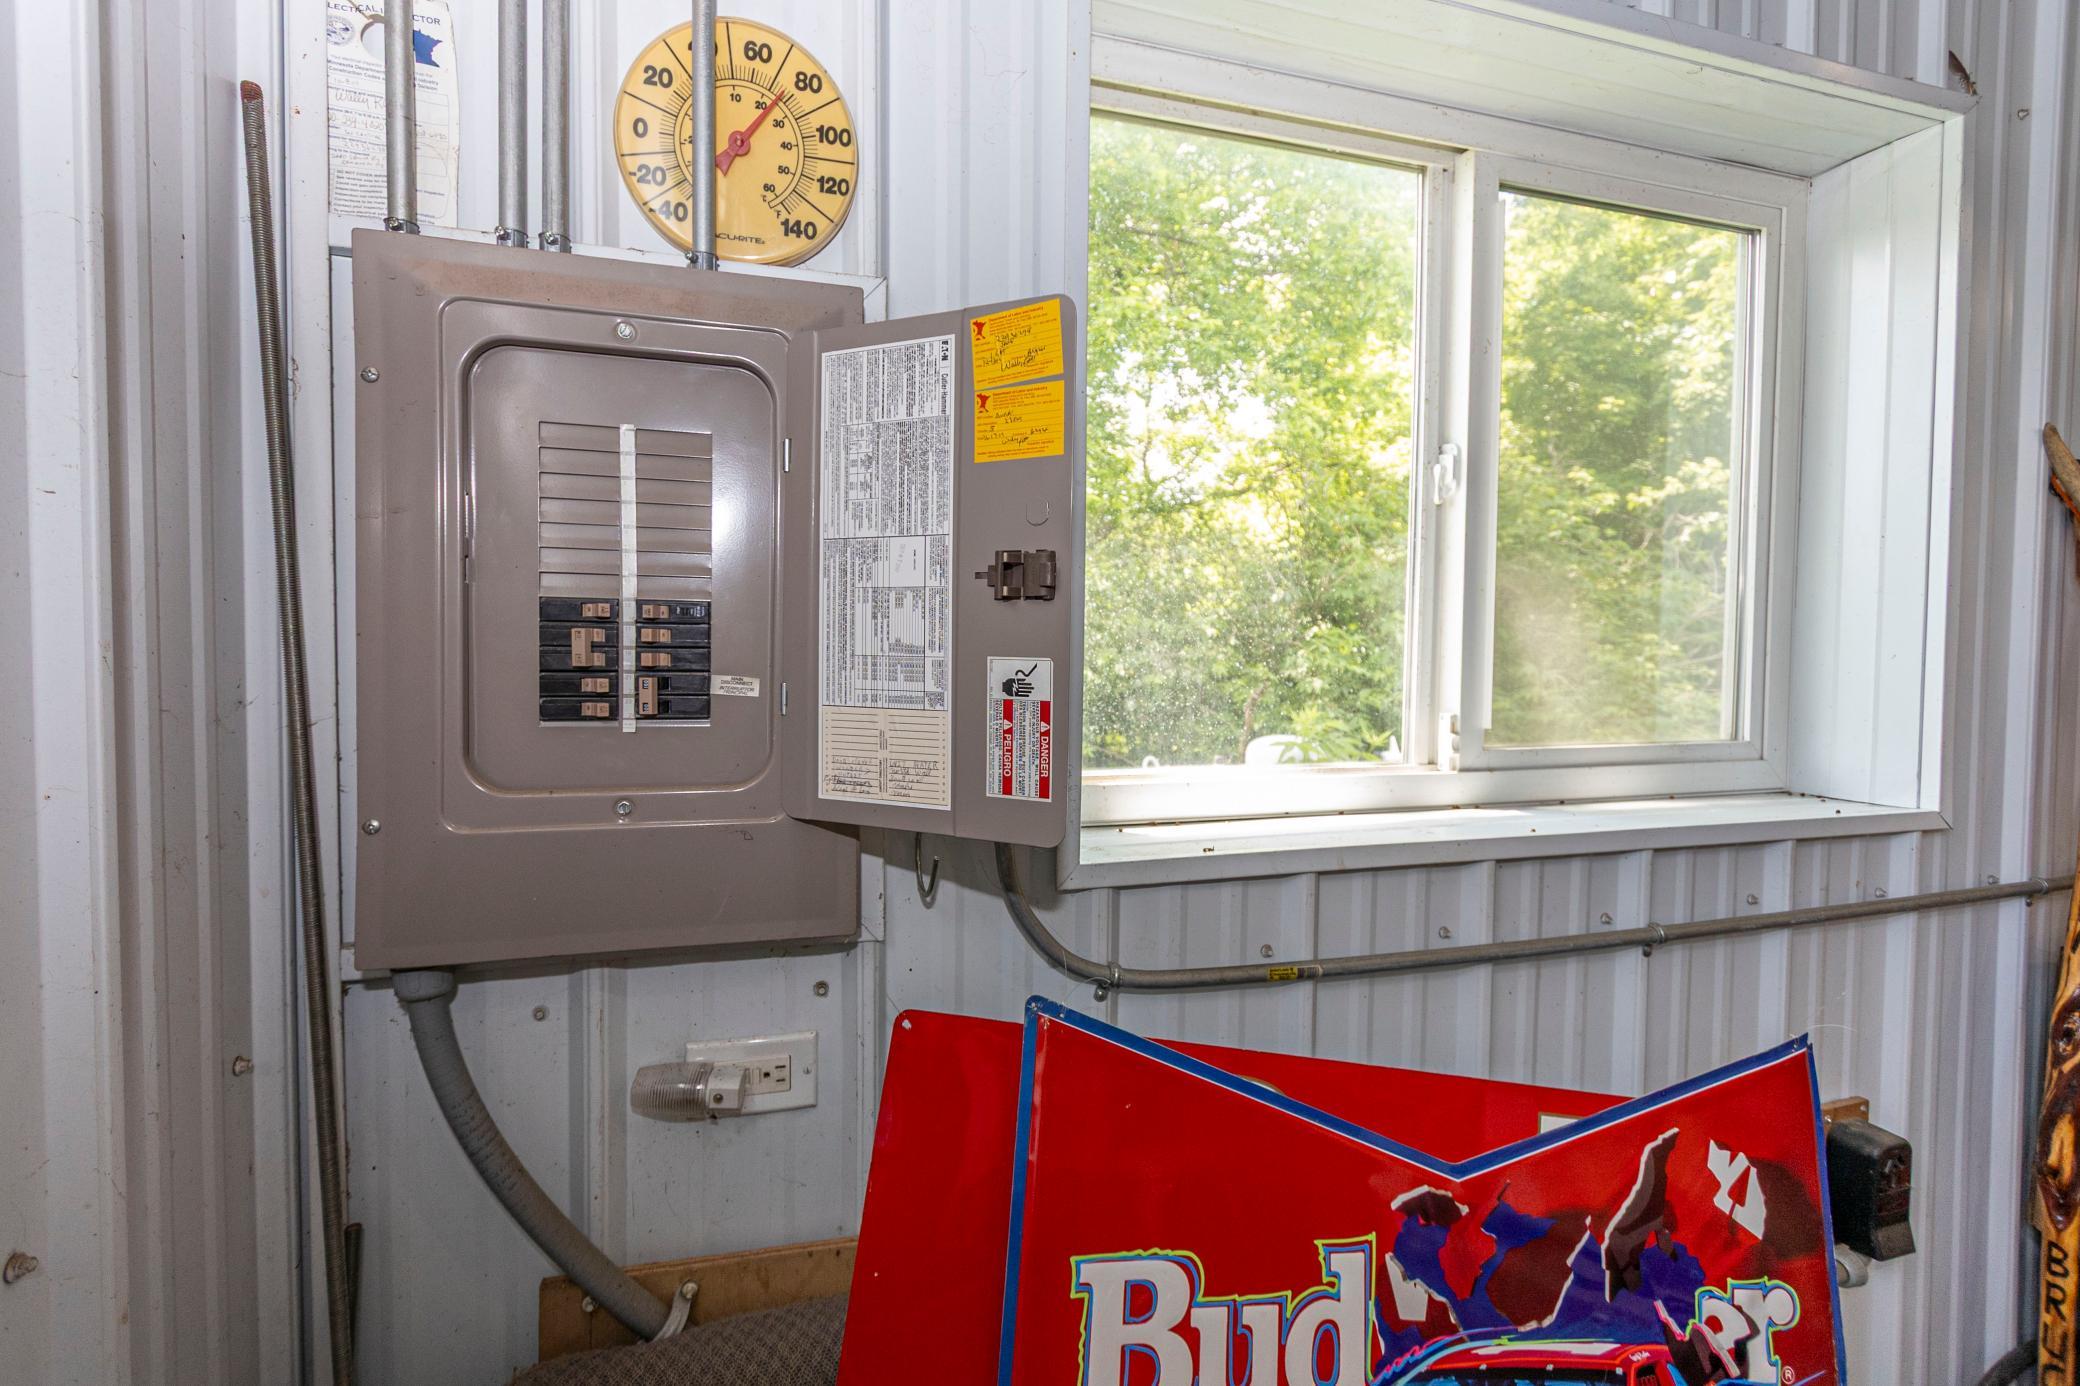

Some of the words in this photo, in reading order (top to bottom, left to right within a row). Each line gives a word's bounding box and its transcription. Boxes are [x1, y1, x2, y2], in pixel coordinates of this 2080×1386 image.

[743, 40, 772, 64] 60
[643, 65, 673, 89] 20
[794, 71, 823, 94] 80
[729, 93, 742, 103] 10
[754, 100, 768, 110] 20
[632, 117, 648, 138] 0
[772, 118, 784, 130] 30
[780, 141, 792, 151] 40
[816, 124, 852, 148] 100
[629, 164, 667, 187] -20
[778, 165, 790, 176] 50
[763, 183, 776, 193] 60
[816, 176, 850, 196] 120
[648, 200, 688, 222] -40
[780, 218, 818, 240] 140
[1040, 736, 1048, 777] DANGER
